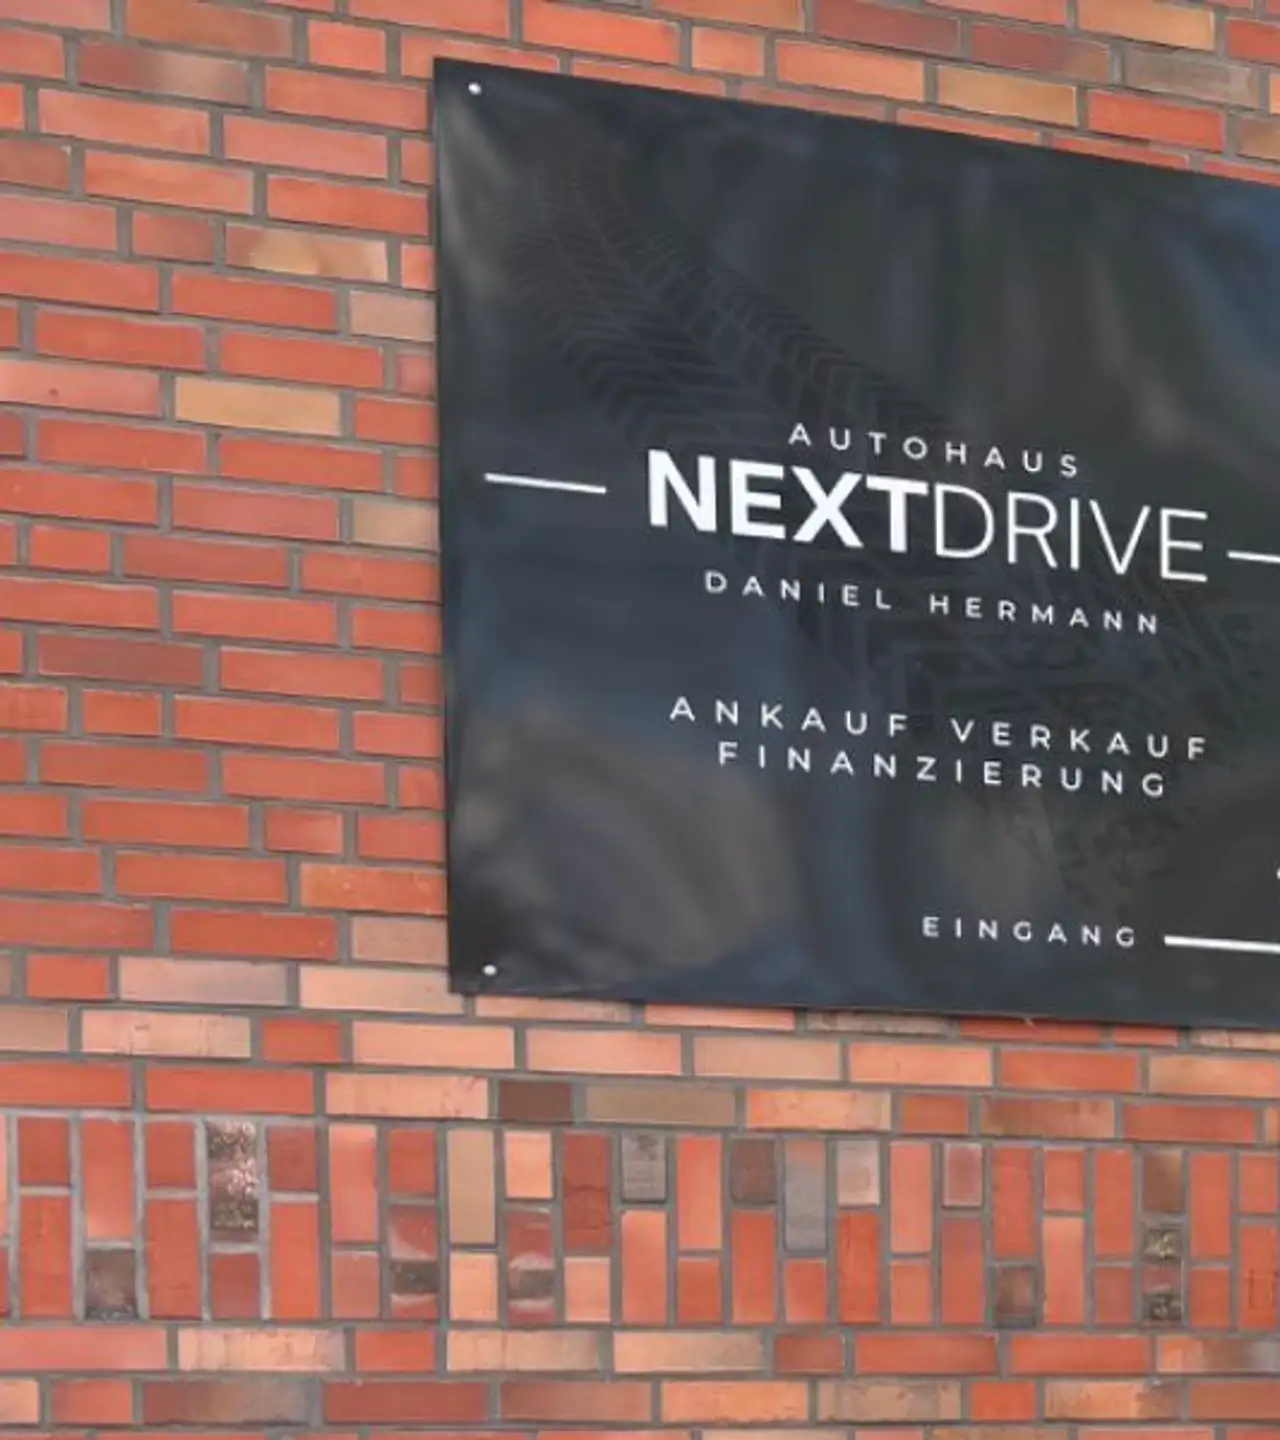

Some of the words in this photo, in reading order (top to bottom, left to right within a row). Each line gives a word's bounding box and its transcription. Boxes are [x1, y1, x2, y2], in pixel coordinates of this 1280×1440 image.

[788, 422, 1078, 478] AUTOHAUS
[648, 449, 1209, 584] NEXTDRIVE
[705, 571, 893, 610] DANIEL
[930, 594, 1158, 634] HERMANN
[669, 696, 908, 737] ANKAUF
[951, 718, 1209, 761] VERKAUF
[718, 741, 1167, 797] FINANZIERUNG
[922, 916, 1135, 947] EINGANG
